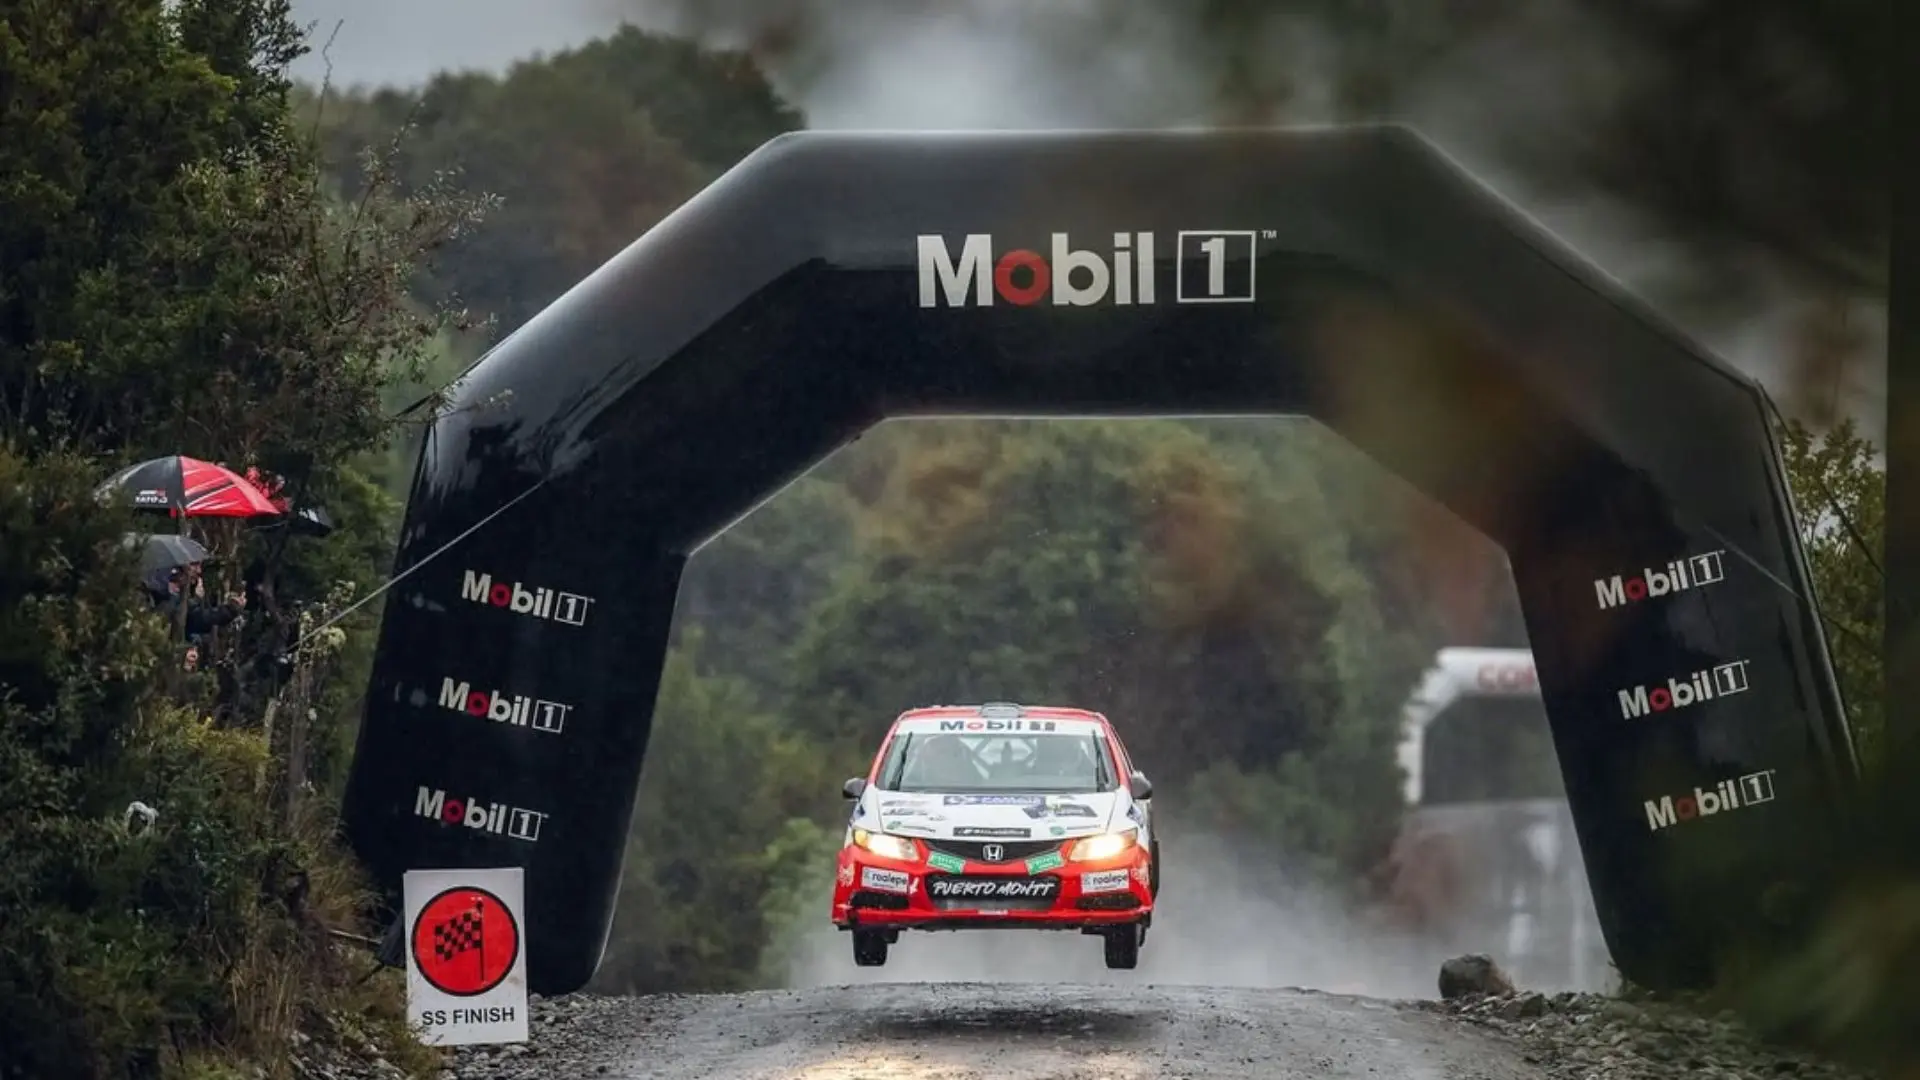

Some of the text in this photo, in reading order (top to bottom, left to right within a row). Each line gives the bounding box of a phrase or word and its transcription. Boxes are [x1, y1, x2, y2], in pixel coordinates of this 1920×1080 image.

[917, 232, 1154, 307] Mobil
[461, 569, 553, 618] Mobil
[1594, 560, 1689, 610] Mobil
[438, 677, 531, 726] Mobil
[1617, 670, 1713, 720] Mobil
[940, 720, 1022, 731] Mobil
[414, 785, 507, 834] Mobil
[1644, 779, 1740, 830] Mobil
[932, 880, 1055, 896] PUERTO MONTT
[421, 1007, 515, 1026] SS FINISH
